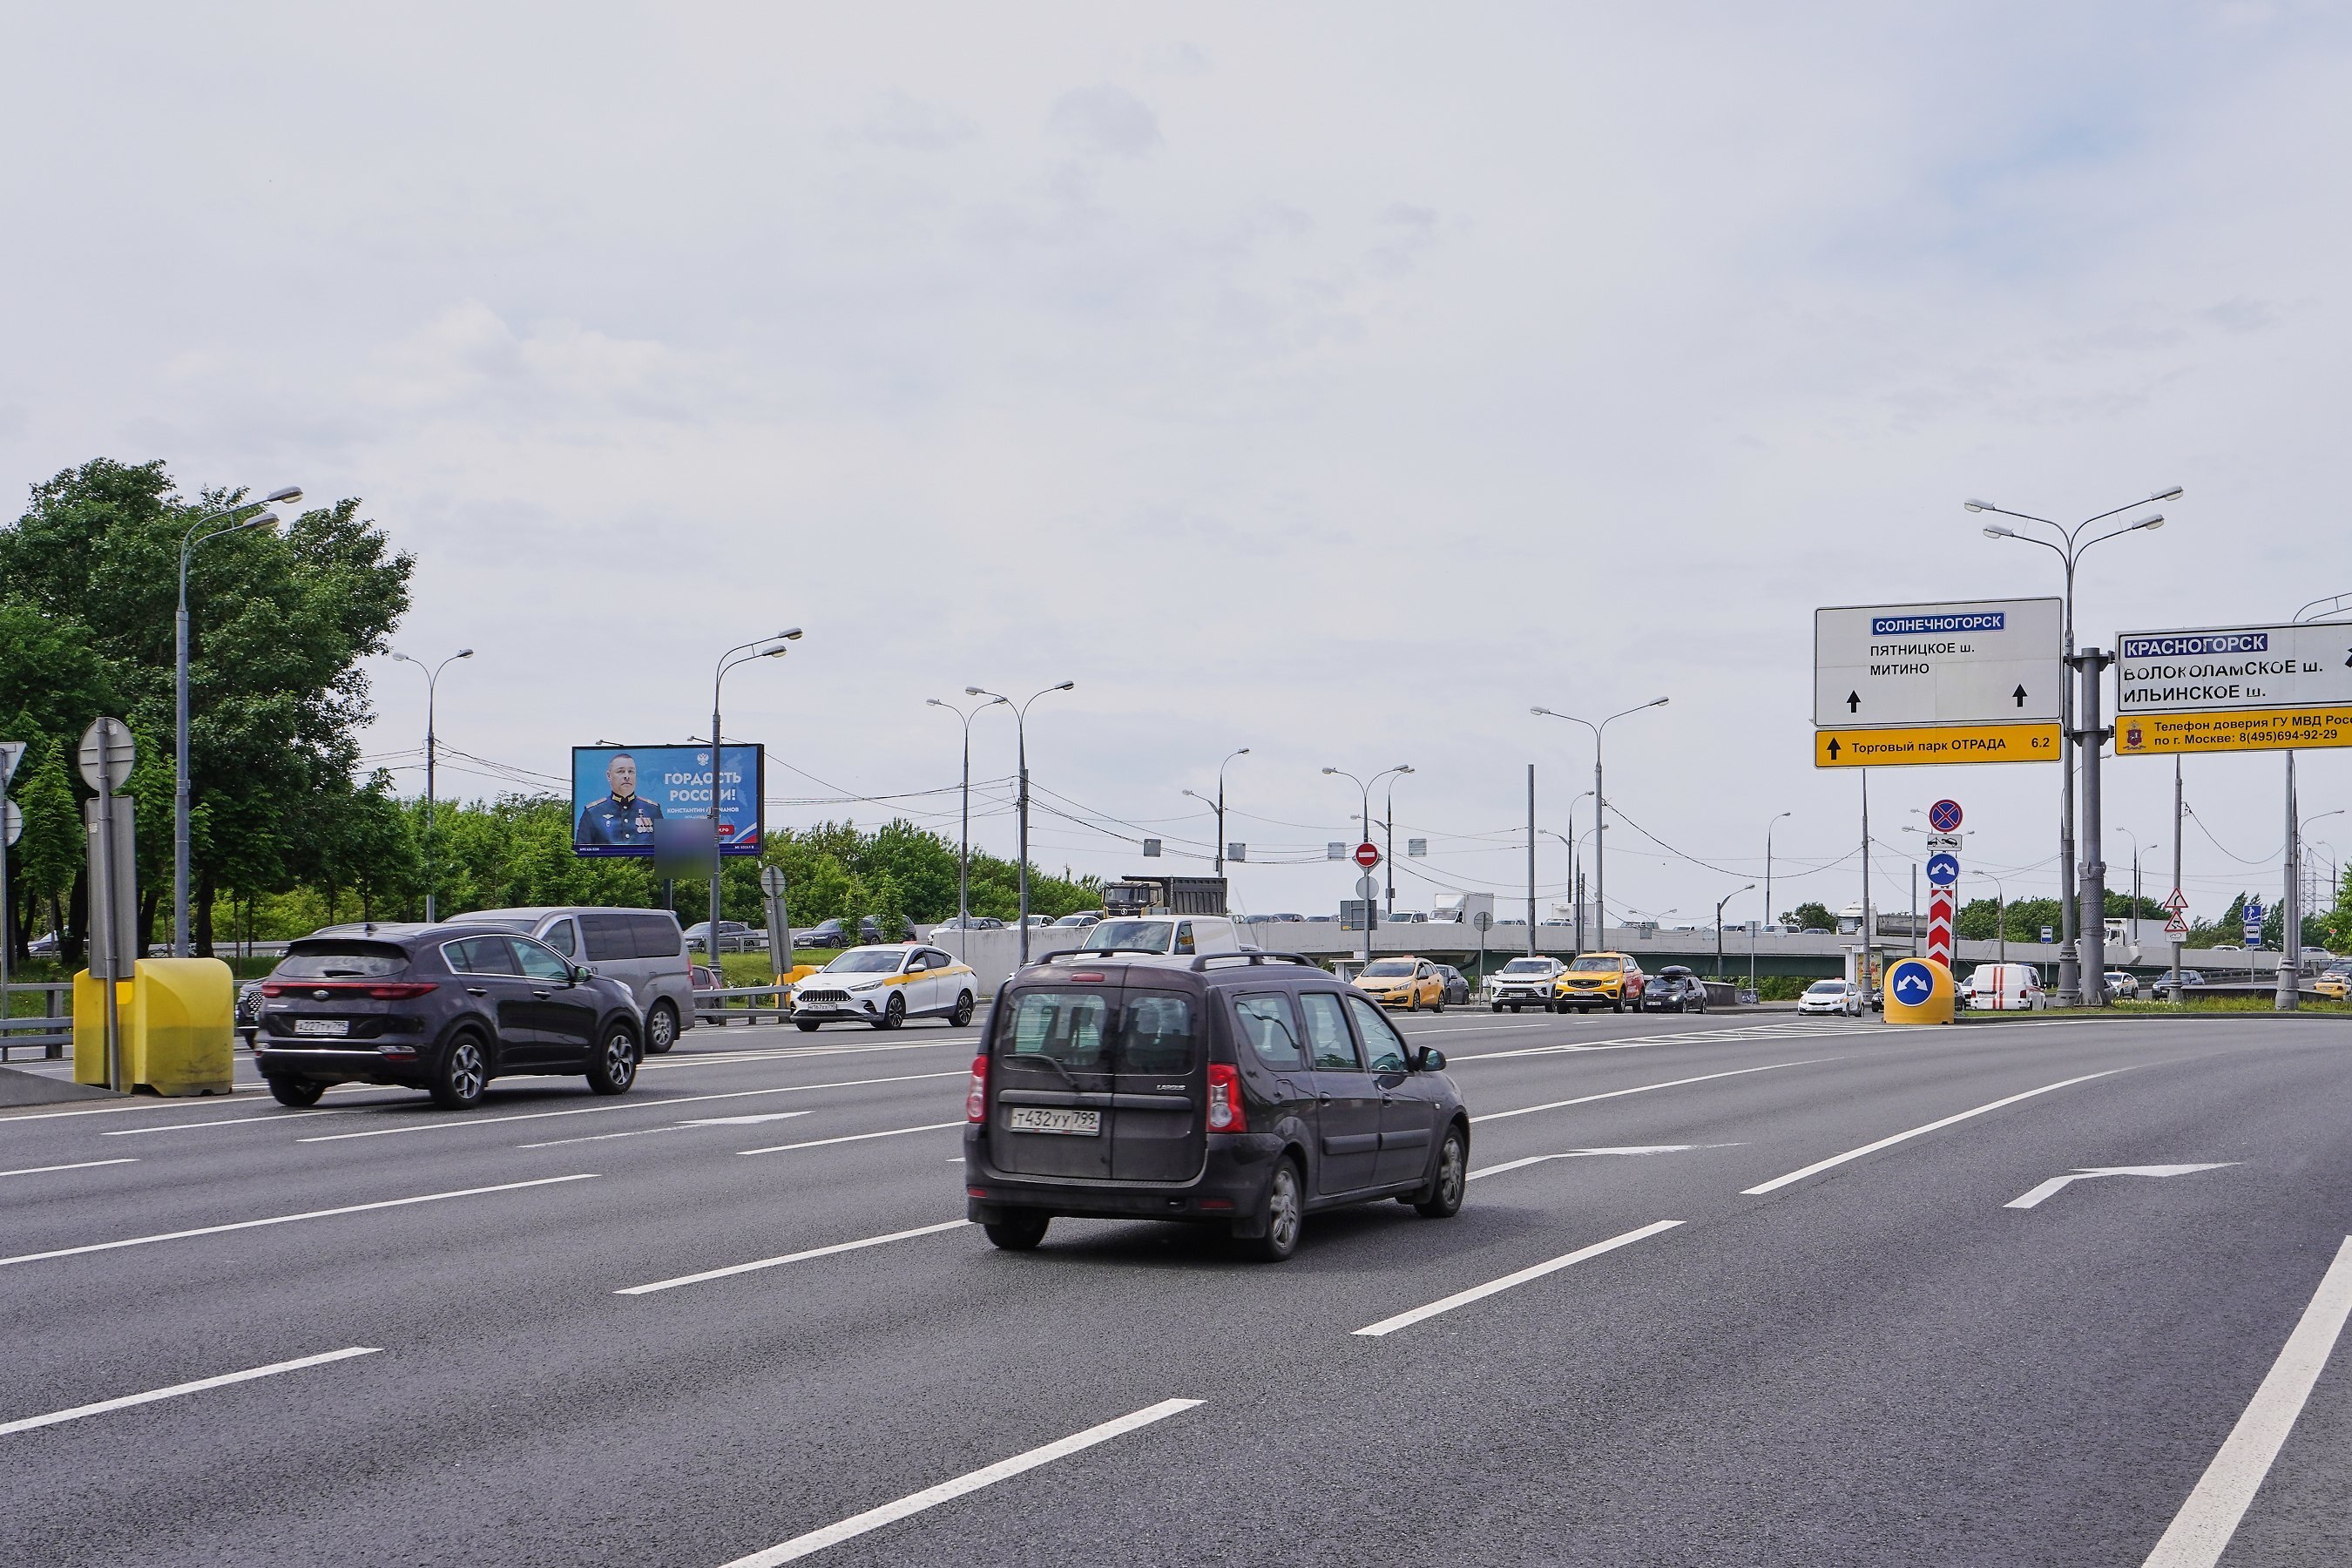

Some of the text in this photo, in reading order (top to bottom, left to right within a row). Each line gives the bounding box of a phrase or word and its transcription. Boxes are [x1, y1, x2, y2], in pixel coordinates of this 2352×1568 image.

[1876, 616, 2001, 632] СОЛНЕЧНОГОРСК
[1870, 642, 1975, 657] ПЯТНИЦКОЕ ш.
[2126, 635, 2265, 657] КРАСНОГОРСК
[1870, 662, 1930, 676] МИТИНО
[2303, 660, 2323, 672] ш.
[2124, 684, 2266, 703] ИЛЬИНСКОЕ ш.
[2154, 720, 2210, 733] Телефон
[2213, 719, 2268, 731] доверия
[2272, 717, 2289, 727] ГУ
[2292, 715, 2322, 727] МВД
[1852, 737, 2051, 755] Торговый парк ОТРАДА 6.2
[2154, 729, 2338, 746] по г. Москве: 8(495)694-92-29
